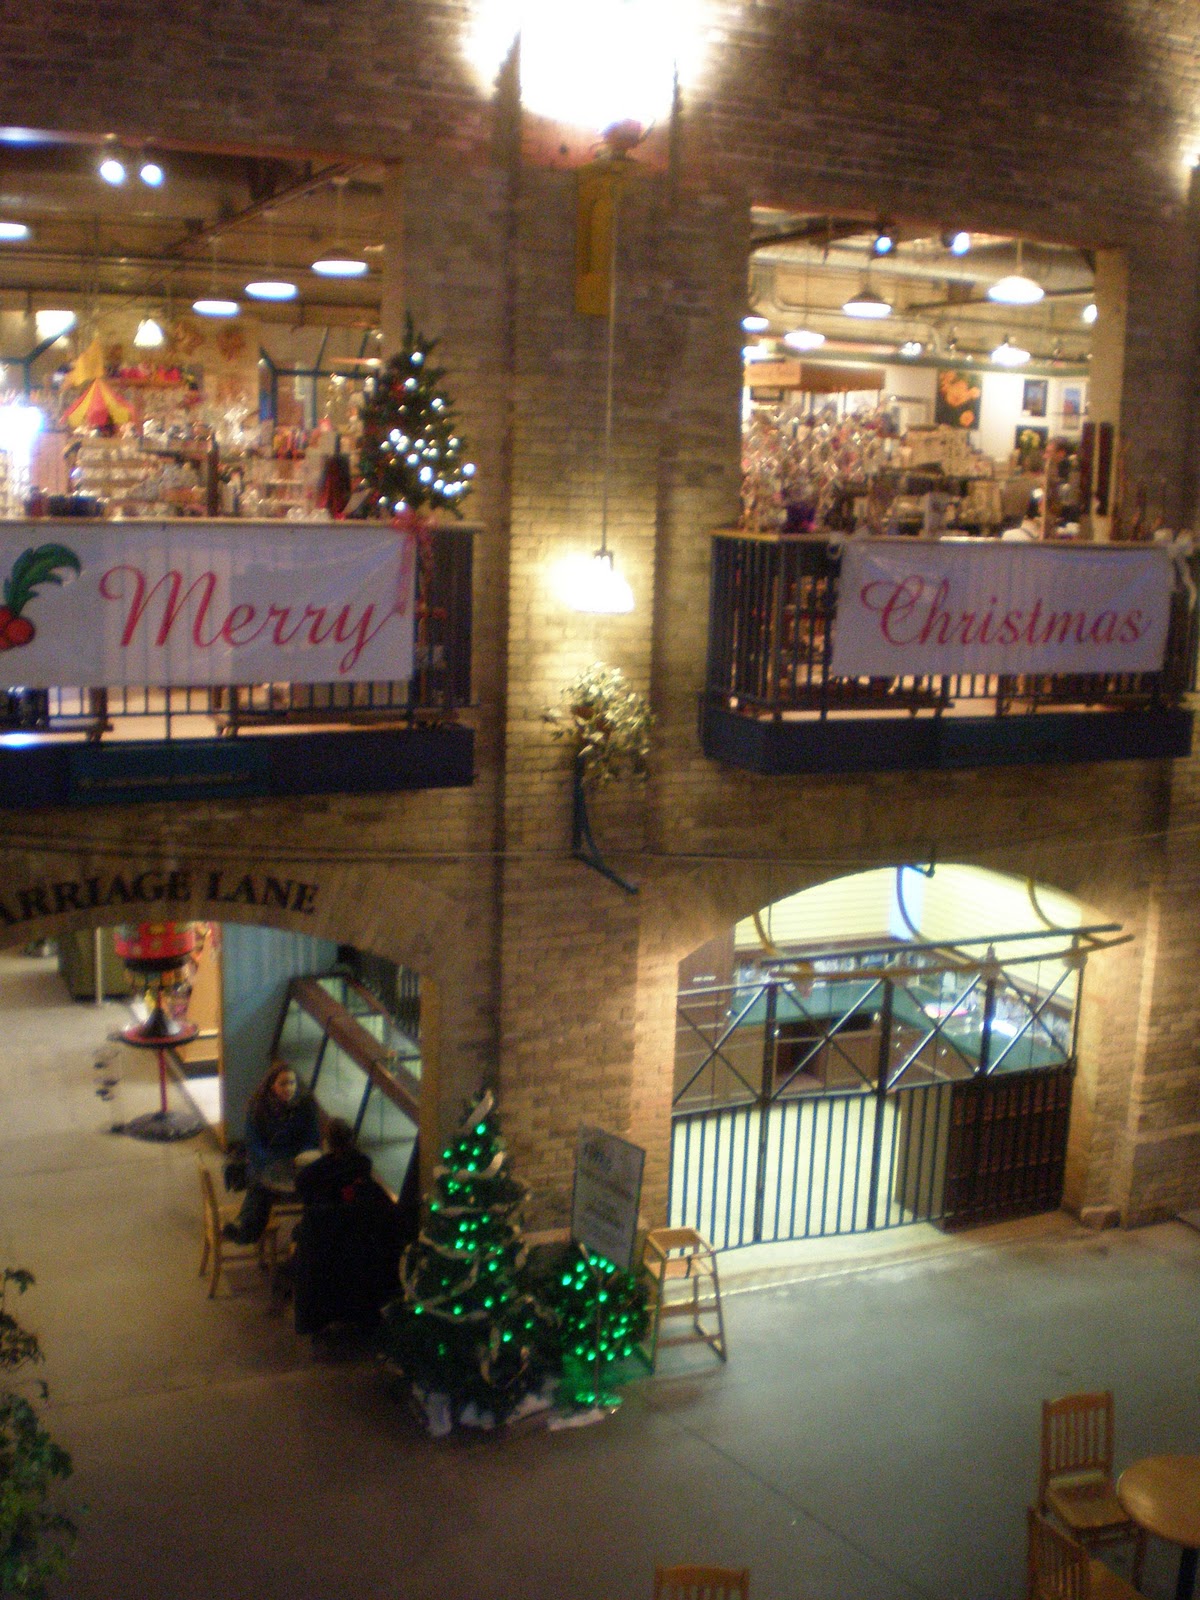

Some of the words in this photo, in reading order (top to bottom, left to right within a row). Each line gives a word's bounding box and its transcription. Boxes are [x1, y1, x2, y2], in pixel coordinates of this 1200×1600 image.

[99, 565, 402, 675] Merry
[860, 574, 1152, 647] Christmas
[206, 871, 320, 915] LANE
